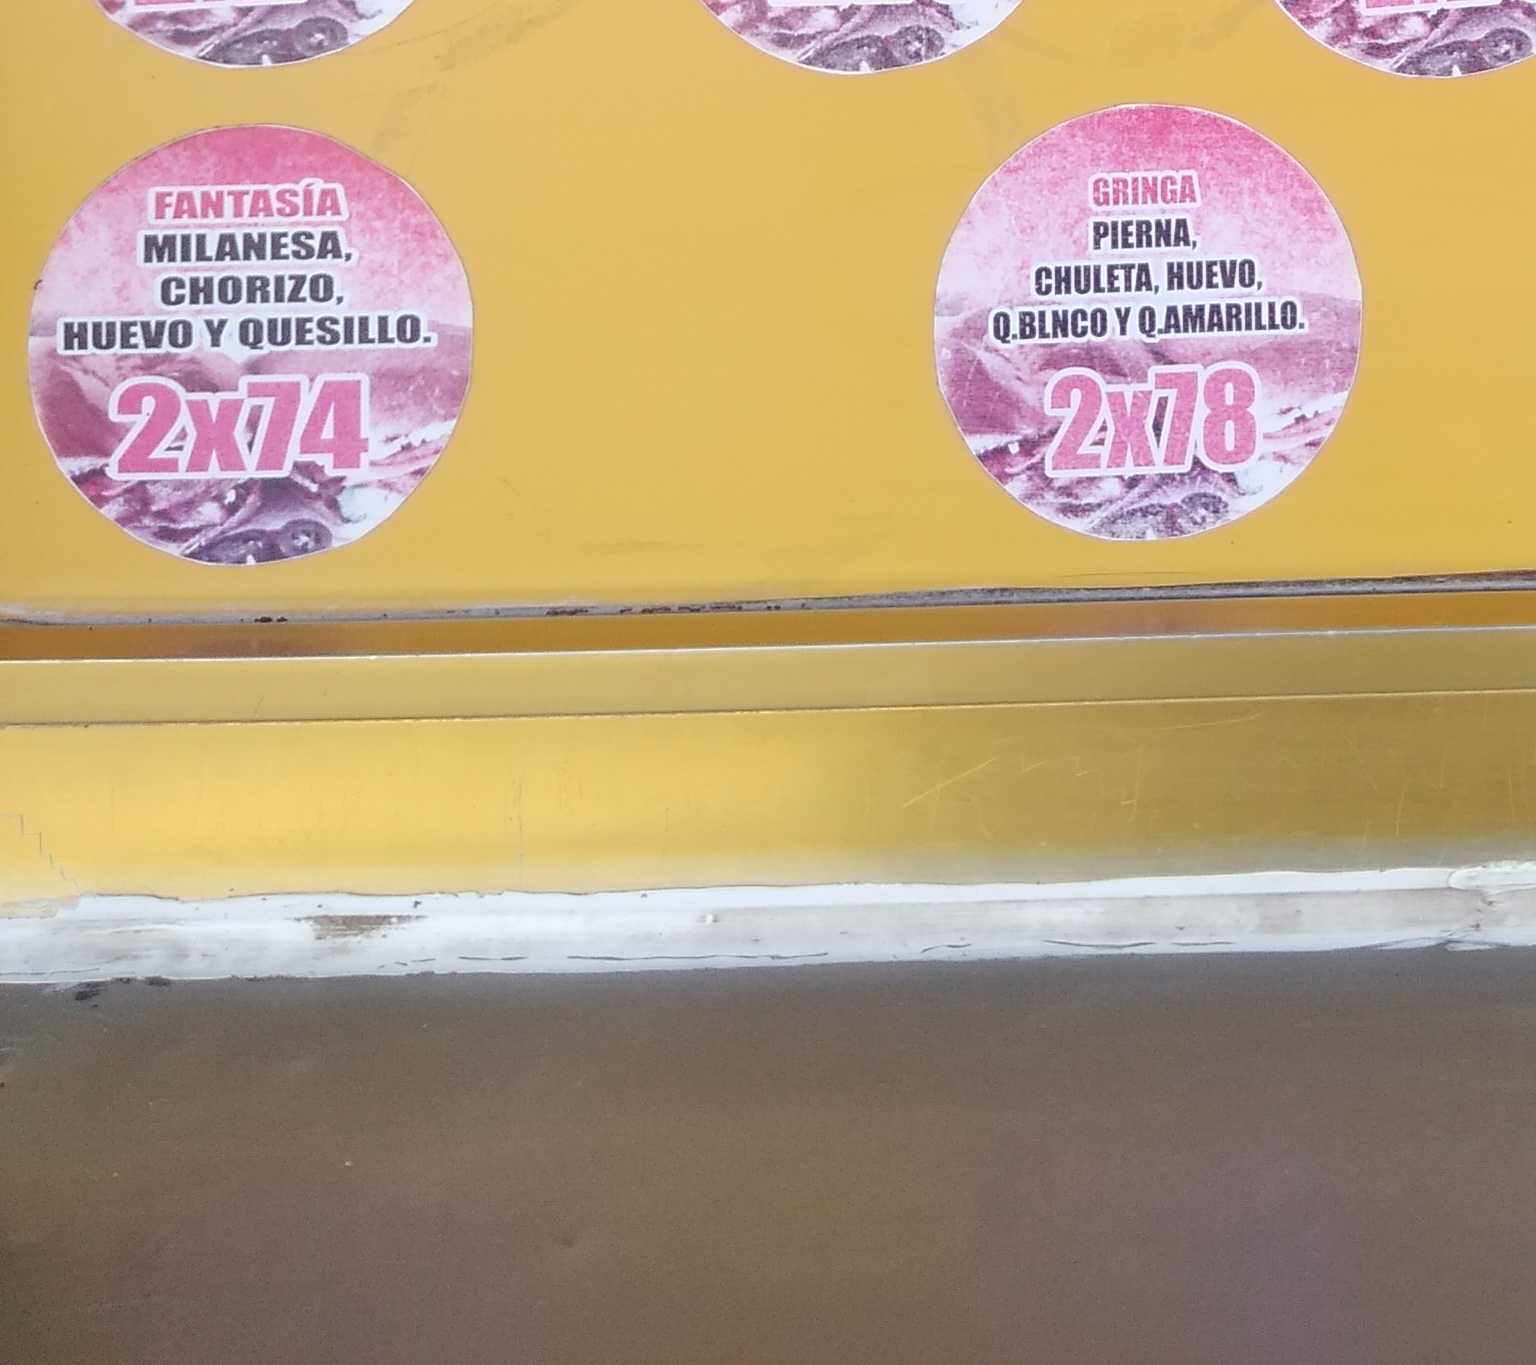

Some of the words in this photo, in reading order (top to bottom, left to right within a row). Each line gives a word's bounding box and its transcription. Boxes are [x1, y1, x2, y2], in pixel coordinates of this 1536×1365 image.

[153, 182, 343, 220] FANTASÍA
[1091, 174, 1198, 207] GRINGA
[142, 230, 354, 265] MILANESA,
[1091, 217, 1198, 252] PIERNA,
[159, 272, 345, 307] CHORIZO,
[1033, 262, 1160, 297] CHULETA,
[1165, 258, 1264, 293] HUEVO,
[62, 318, 195, 352] HUEVO
[202, 317, 228, 349] Y
[237, 312, 433, 349] QUESILLO.
[1114, 306, 1132, 337] Y
